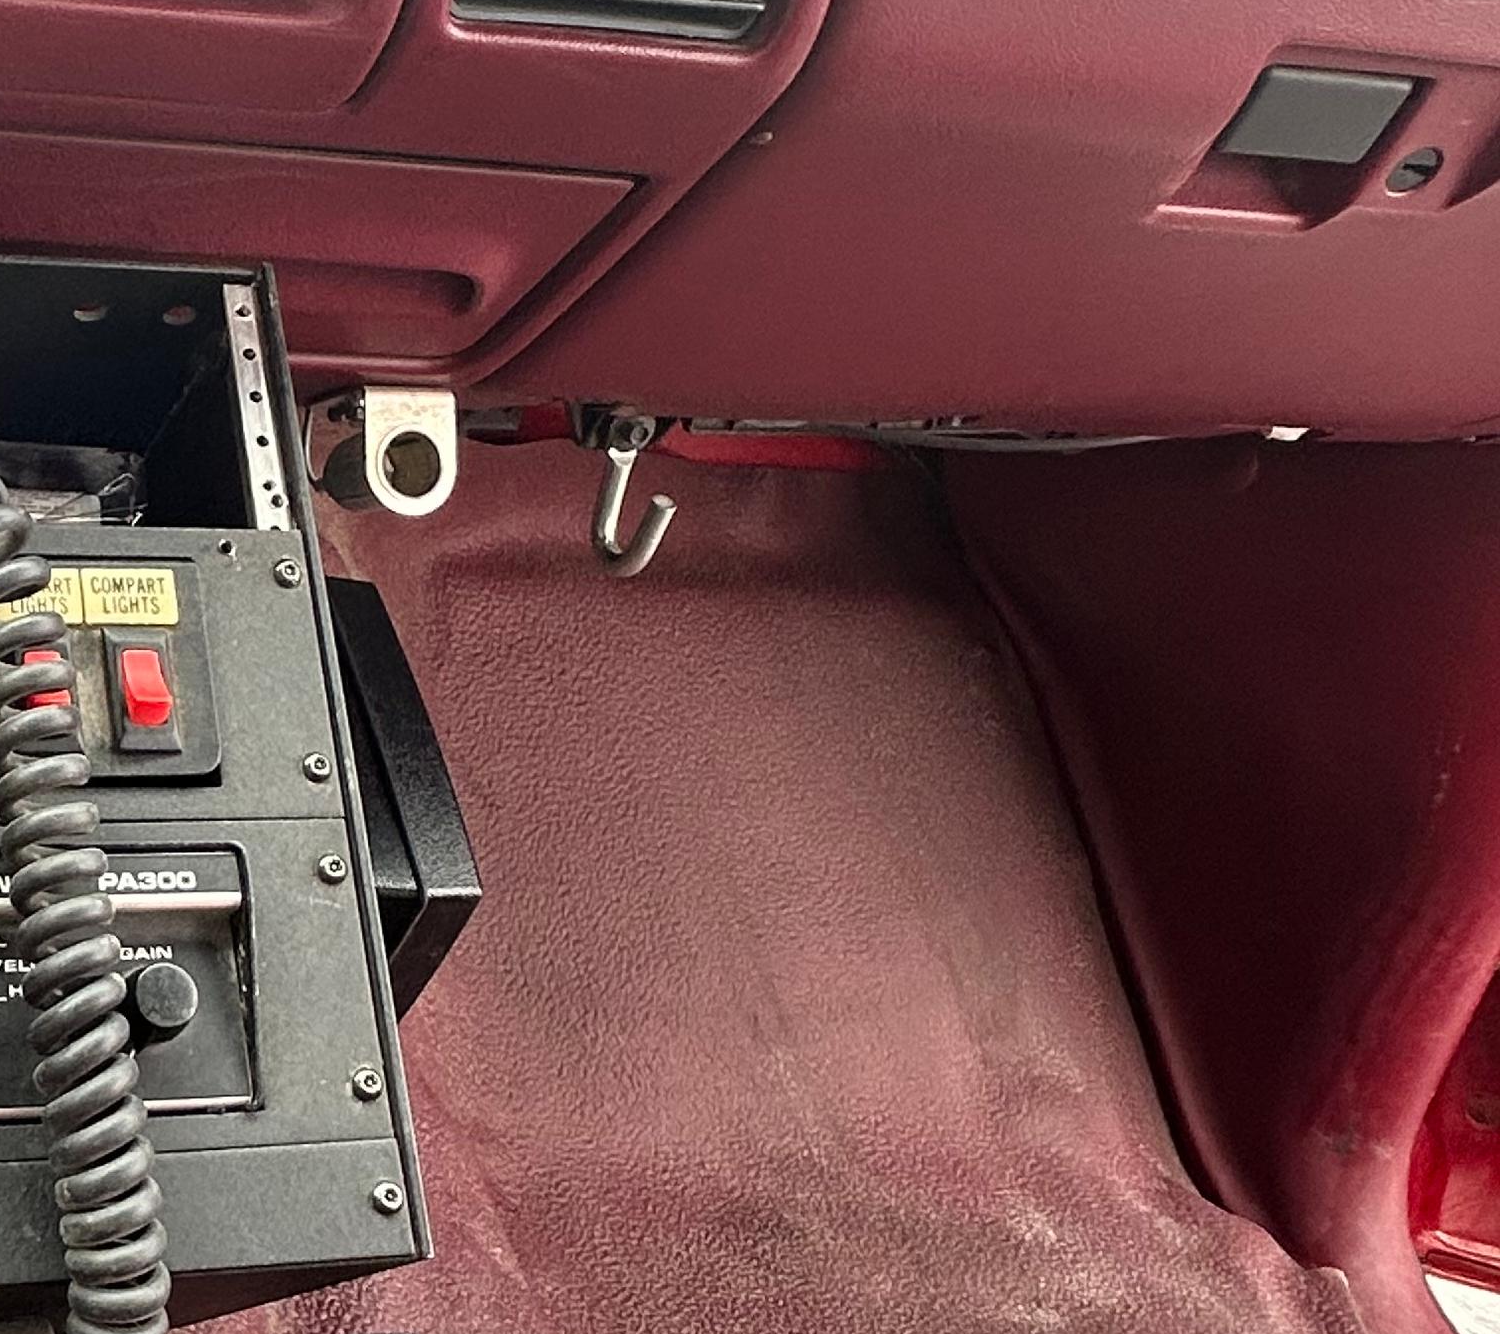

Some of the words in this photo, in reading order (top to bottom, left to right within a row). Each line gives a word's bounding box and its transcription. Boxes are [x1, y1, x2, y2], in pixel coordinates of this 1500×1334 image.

[89, 575, 166, 595] COMPART
[9, 596, 70, 616] LIGHTS
[101, 595, 161, 615] LIGHTS
[97, 869, 198, 892] PA300
[119, 944, 173, 962] GAIN
